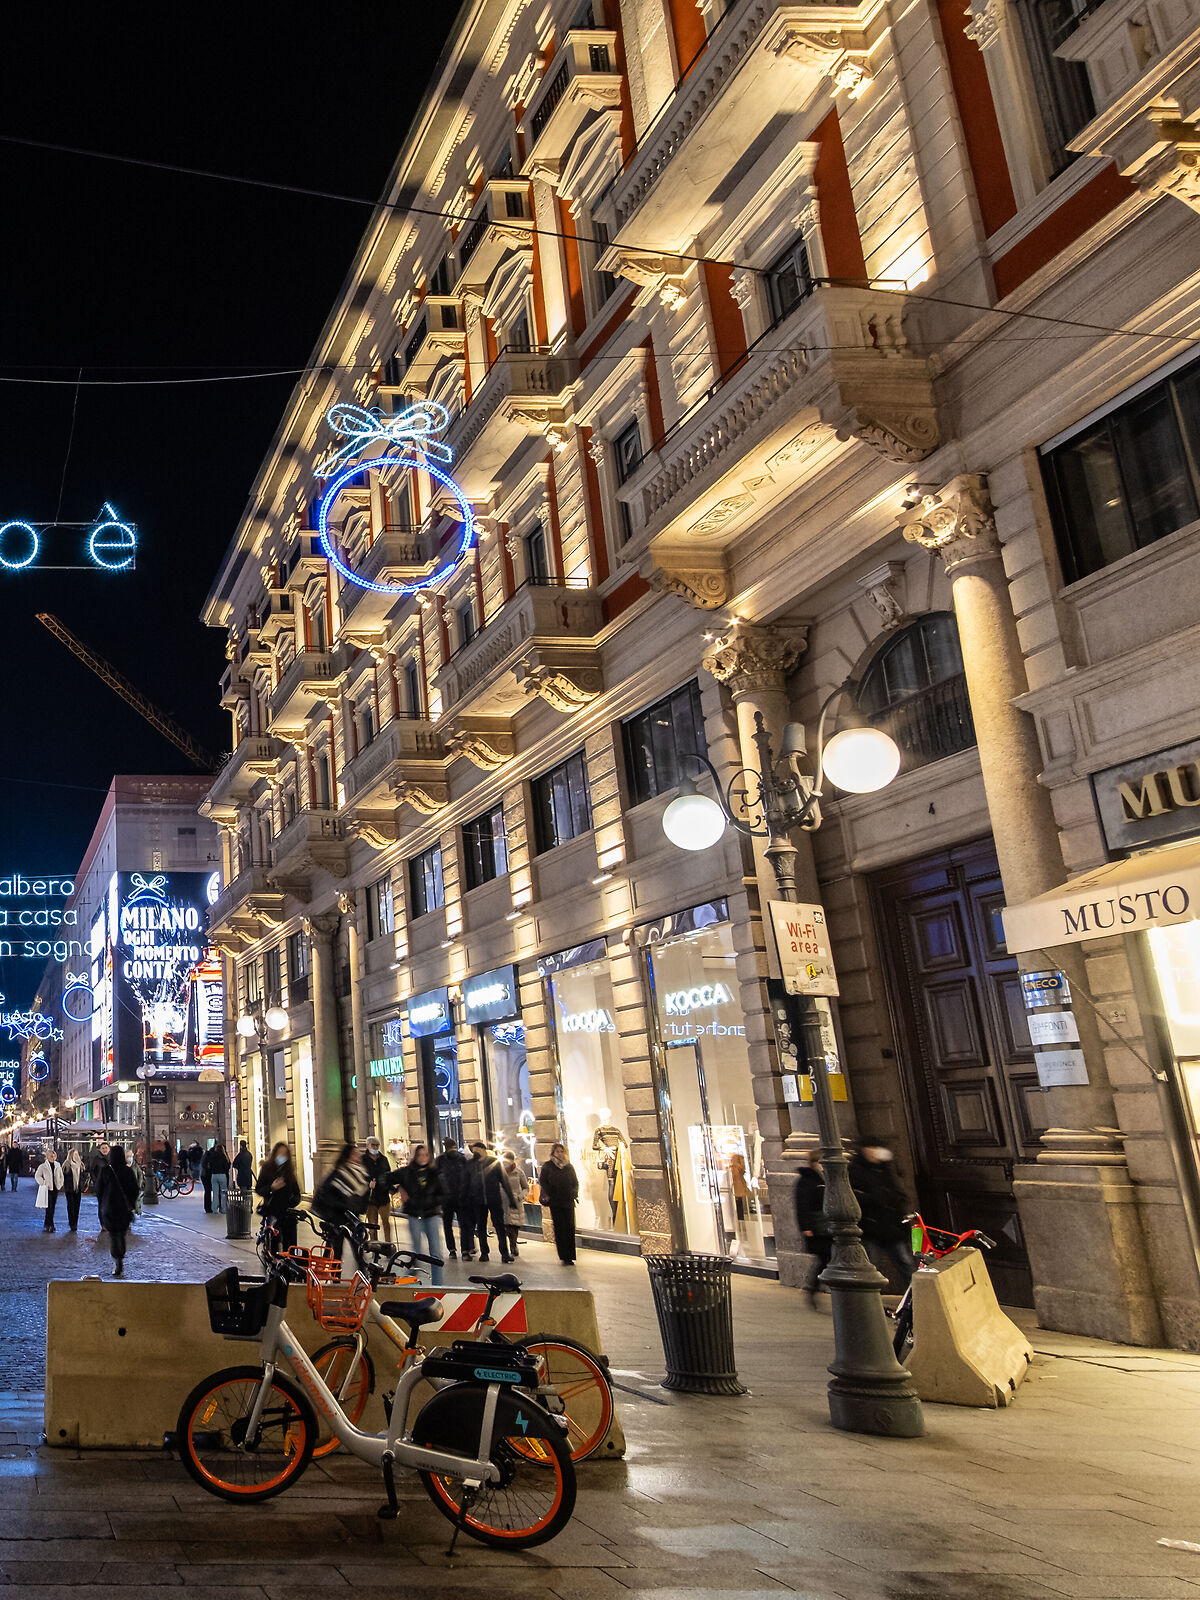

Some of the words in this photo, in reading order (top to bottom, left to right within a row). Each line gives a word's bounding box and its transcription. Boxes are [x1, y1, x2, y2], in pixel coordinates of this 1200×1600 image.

[88, 501, 137, 569] è
[18, 908, 78, 927] casa
[121, 906, 203, 932] MILANO,
[1060, 885, 1190, 936] MUSTO
[123, 930, 155, 946] OGNI
[786, 921, 817, 940] Wi-Fi
[133, 945, 199, 962] MOMENTO
[790, 940, 820, 954] area
[123, 960, 174, 980] CONTA
[665, 982, 732, 1013] KOCCA
[561, 1008, 611, 1033] KOCCA
[483, 1370, 517, 1381] ELECTRIC
[290, 1355, 338, 1420] ridemovi
